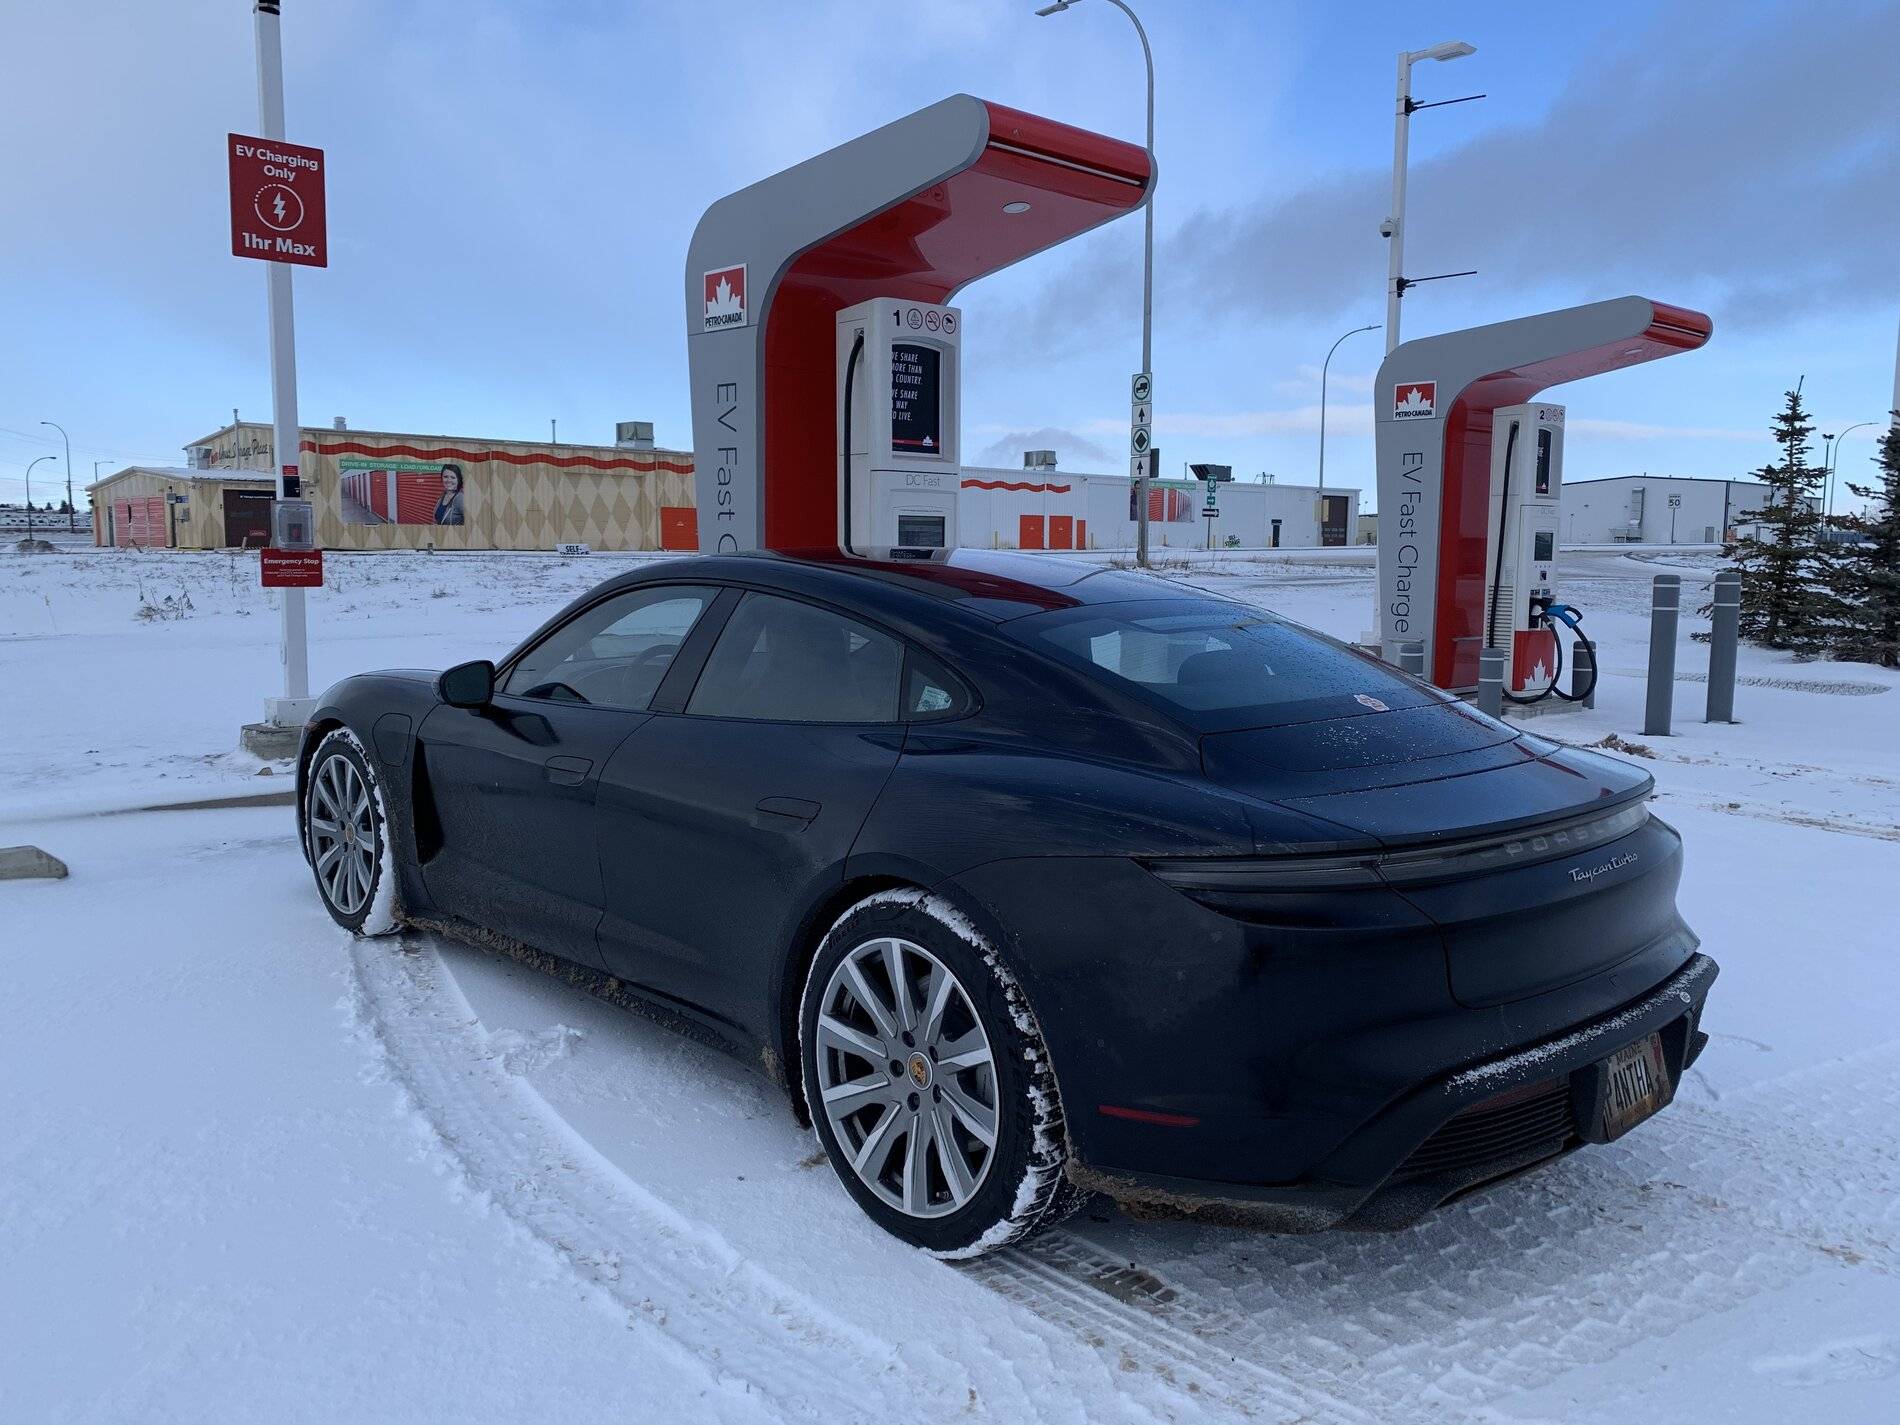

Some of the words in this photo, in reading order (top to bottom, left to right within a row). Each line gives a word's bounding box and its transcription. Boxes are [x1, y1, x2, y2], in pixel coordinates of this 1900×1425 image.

[235, 144, 254, 158] EV
[256, 148, 319, 171] Charging
[263, 164, 296, 182] Only
[242, 232, 272, 250] 1hr
[275, 237, 316, 257] Max
[705, 311, 743, 328] PETRO-CANADA
[893, 309, 901, 327] 1
[900, 352, 919, 363] SHARE
[908, 364, 923, 374] THAN
[900, 389, 919, 400] SHARE
[717, 383, 738, 433] EV
[895, 401, 908, 410] WAY
[898, 411, 913, 421] LIVE.
[1395, 410, 1433, 418] PETRO-CANADA
[1539, 410, 1545, 420] 2
[1402, 452, 1424, 484] EV
[717, 447, 738, 522] Fast
[906, 474, 921, 486] DC
[923, 475, 940, 487] Fast
[1668, 499, 1680, 507] 50
[1400, 491, 1422, 538] Fast
[263, 558, 303, 566] Emergency
[1390, 544, 1419, 633] Charge
